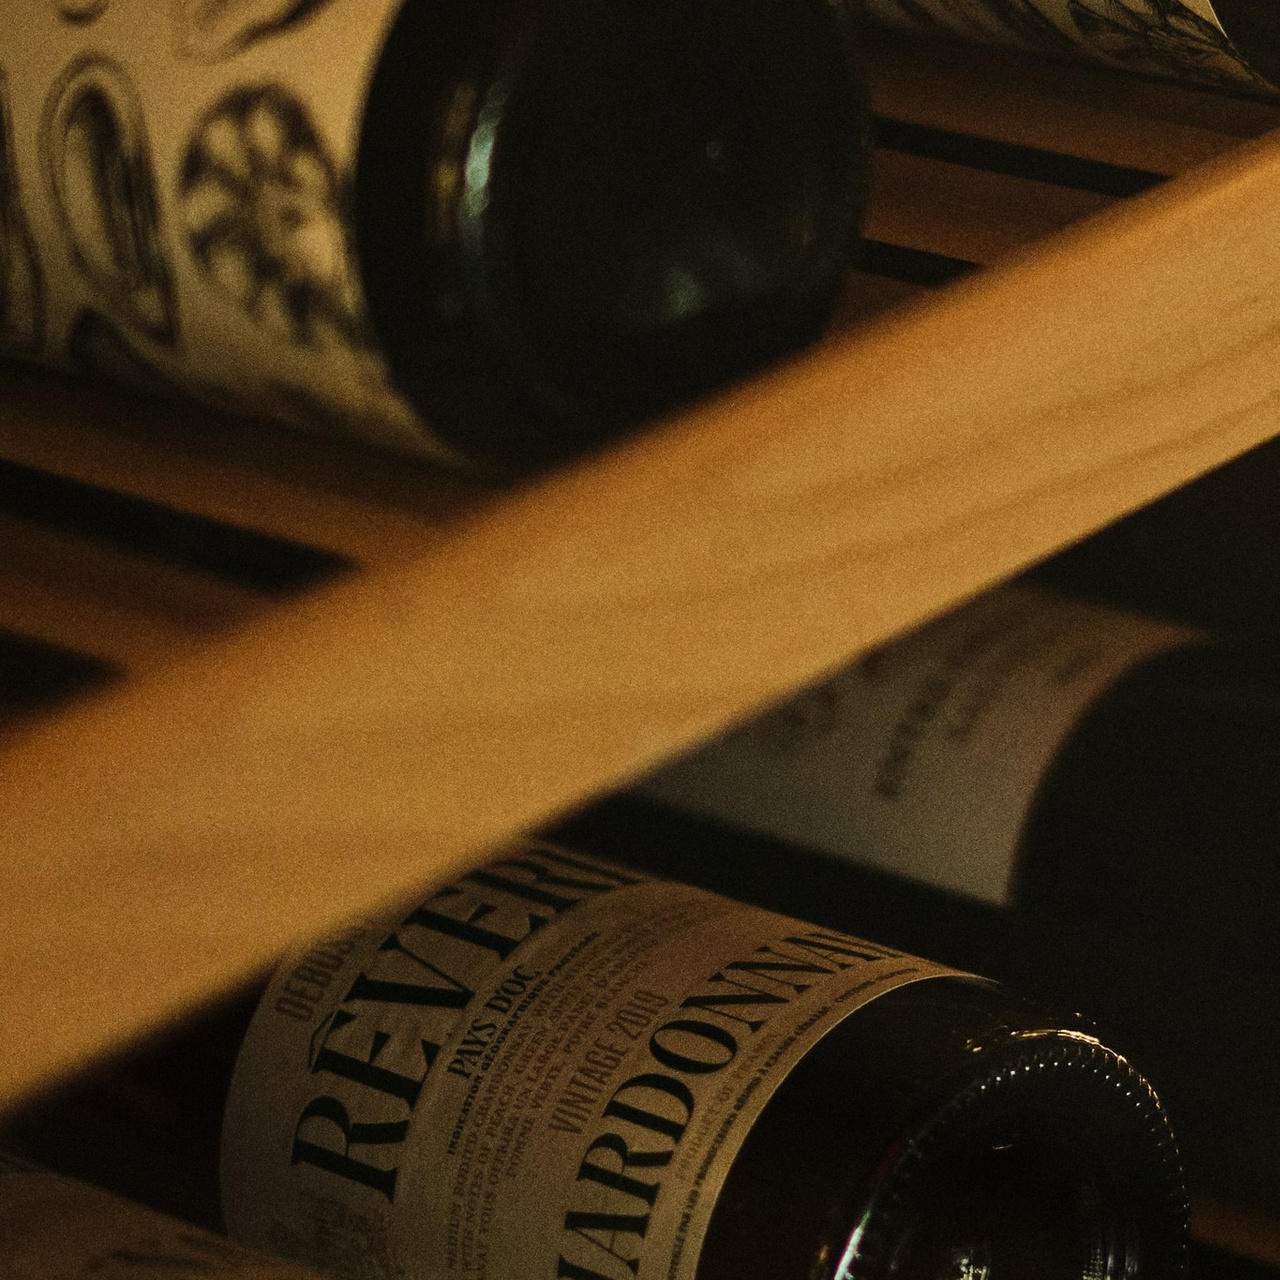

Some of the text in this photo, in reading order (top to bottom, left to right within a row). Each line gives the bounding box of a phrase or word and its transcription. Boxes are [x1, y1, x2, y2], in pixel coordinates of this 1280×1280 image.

[274, 927, 366, 1021] DEBUS
[291, 848, 643, 1204] RÊVERI
[445, 963, 541, 1080] PAYS D'OC
[446, 1073, 485, 1156] INDICATION
[547, 1032, 629, 1135] VINTAGE
[603, 984, 671, 1037] 2019
